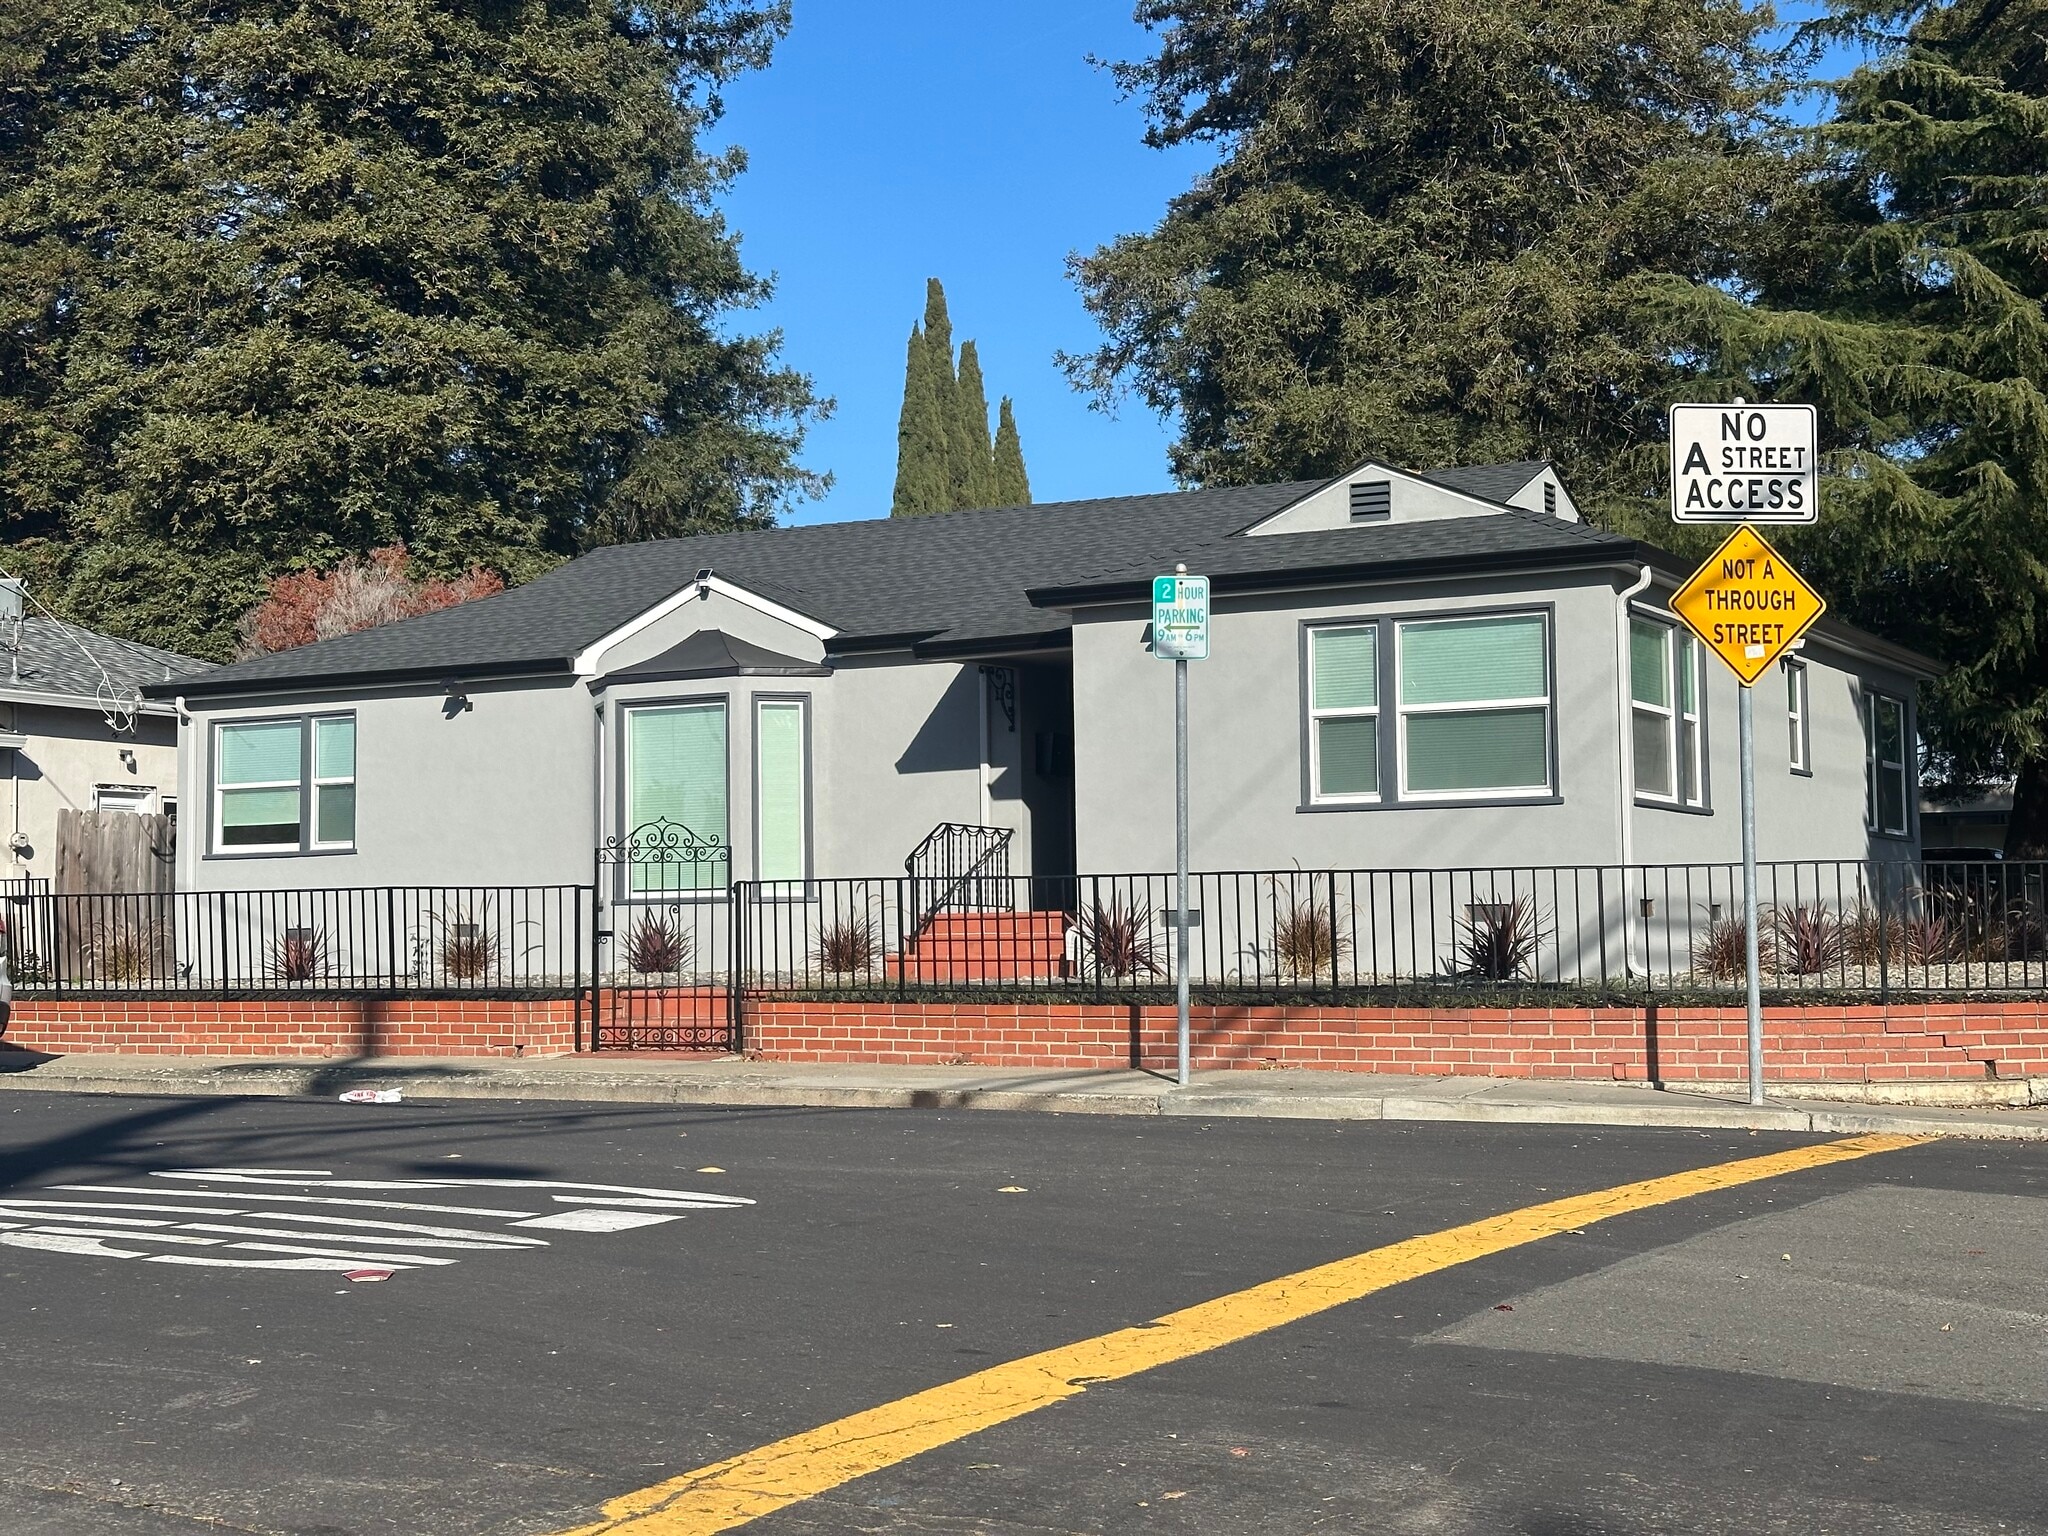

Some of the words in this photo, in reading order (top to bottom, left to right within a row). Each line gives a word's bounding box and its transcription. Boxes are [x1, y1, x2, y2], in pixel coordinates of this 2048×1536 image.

[1722, 413, 1767, 441] NO
[1682, 442, 1712, 475] A
[1722, 447, 1806, 469] STREET
[1686, 479, 1804, 509] ACCESS
[1723, 559, 1755, 580] NOT
[1763, 559, 1775, 580] A
[1162, 583, 1171, 599] 2
[1177, 587, 1204, 600] HOUR
[1705, 590, 1796, 611] THROUGH
[1158, 608, 1204, 624] PARKING
[1713, 623, 1784, 645] STREET
[0, 1167, 757, 1271] STOP
